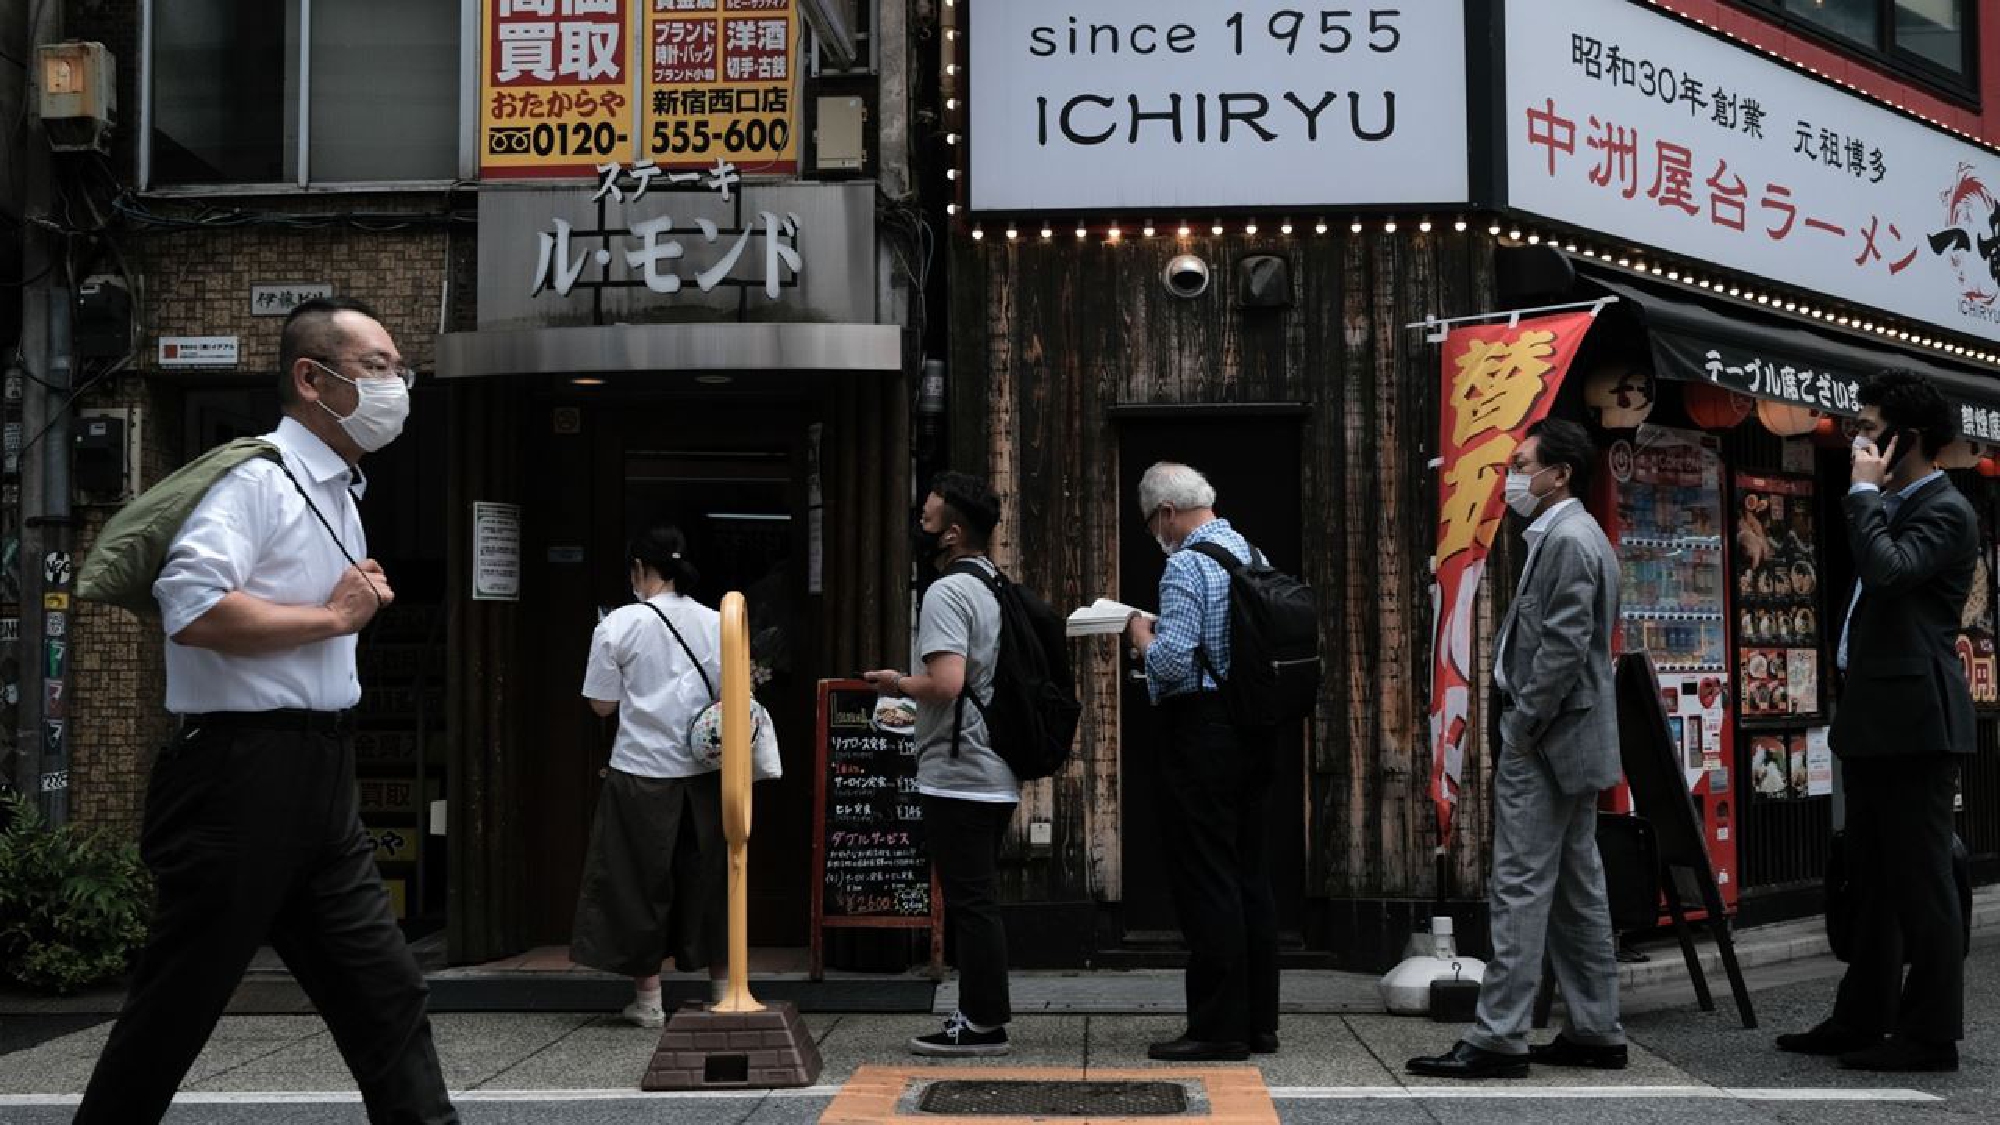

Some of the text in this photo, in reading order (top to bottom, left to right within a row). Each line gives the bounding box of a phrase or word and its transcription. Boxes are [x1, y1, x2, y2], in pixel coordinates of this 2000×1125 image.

[497, 22, 620, 83] 買取
[655, 22, 716, 43] ブランド
[727, 20, 787, 50] 洋酒
[1029, 9, 1401, 57] since 1955
[491, 89, 626, 119] おたからや
[652, 86, 788, 116] 新宿西口店
[1036, 91, 1397, 146] ICHIRYU
[1571, 33, 1887, 184] 昭和30年創業 元祖博多
[533, 122, 628, 157] 0120-
[651, 118, 789, 154] 555-600
[593, 157, 741, 202] ステーキ
[1526, 98, 1918, 275] 中洲屋台ラーメン
[532, 211, 803, 299] ル・モンド
[1705, 349, 1863, 412] テーブル席ございま
